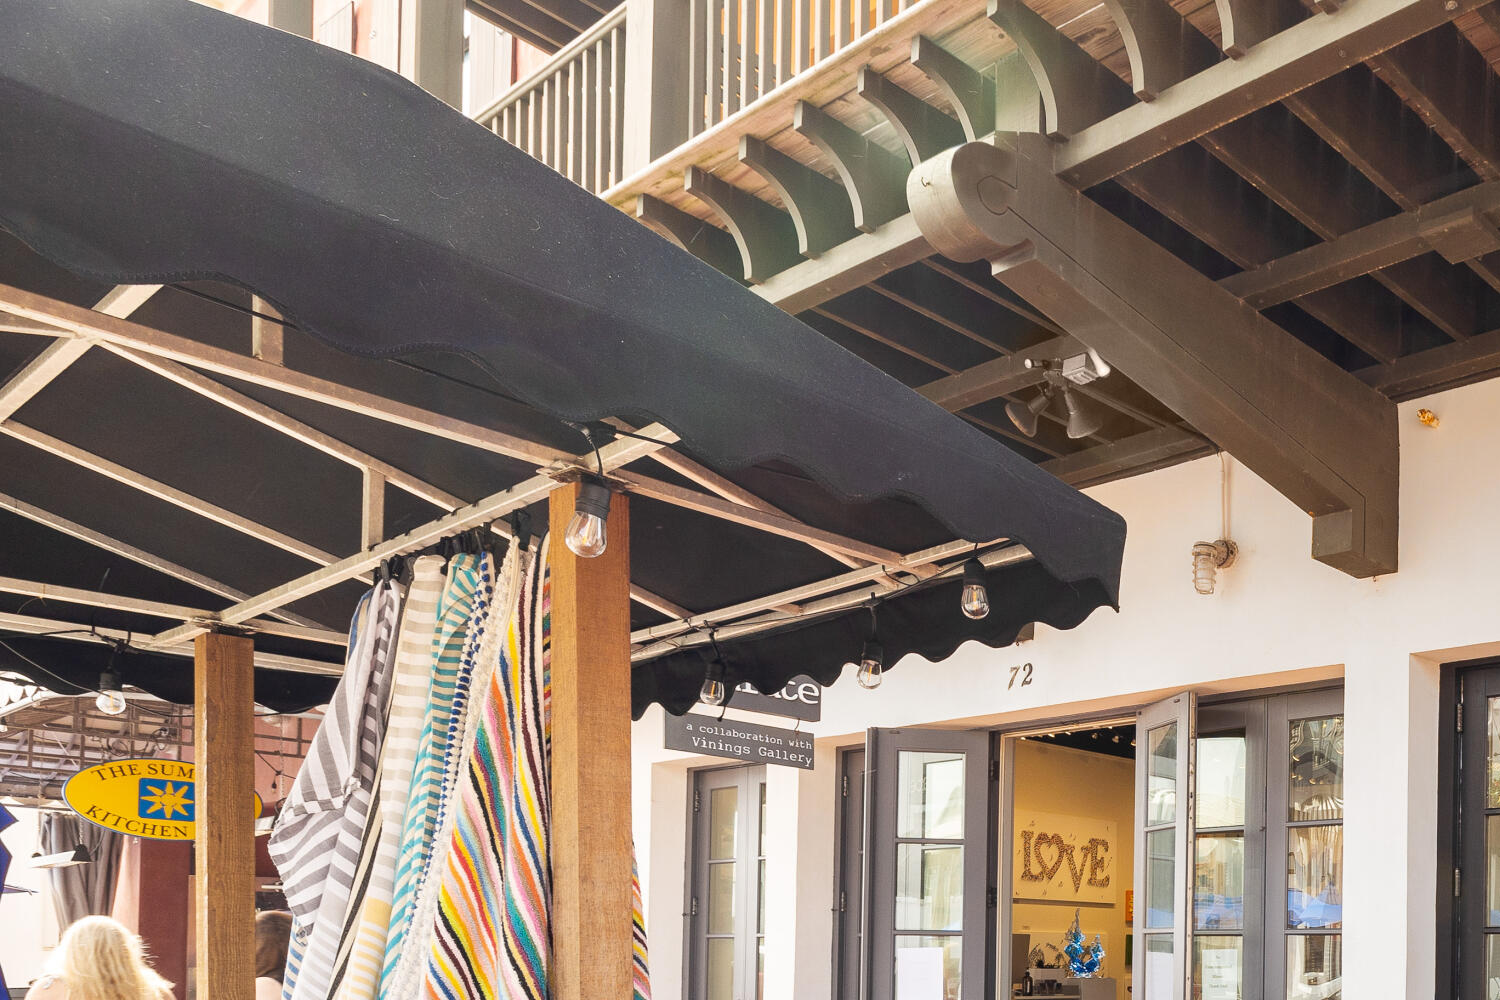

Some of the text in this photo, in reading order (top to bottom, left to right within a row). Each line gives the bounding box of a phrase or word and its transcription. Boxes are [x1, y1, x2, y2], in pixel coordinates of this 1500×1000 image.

[1008, 662, 1033, 690] 72
[686, 723, 812, 750] a collaboration with
[692, 736, 813, 767] Vinings Gallery
[91, 763, 195, 780] THE SUM
[85, 804, 188, 838] KITCHEN
